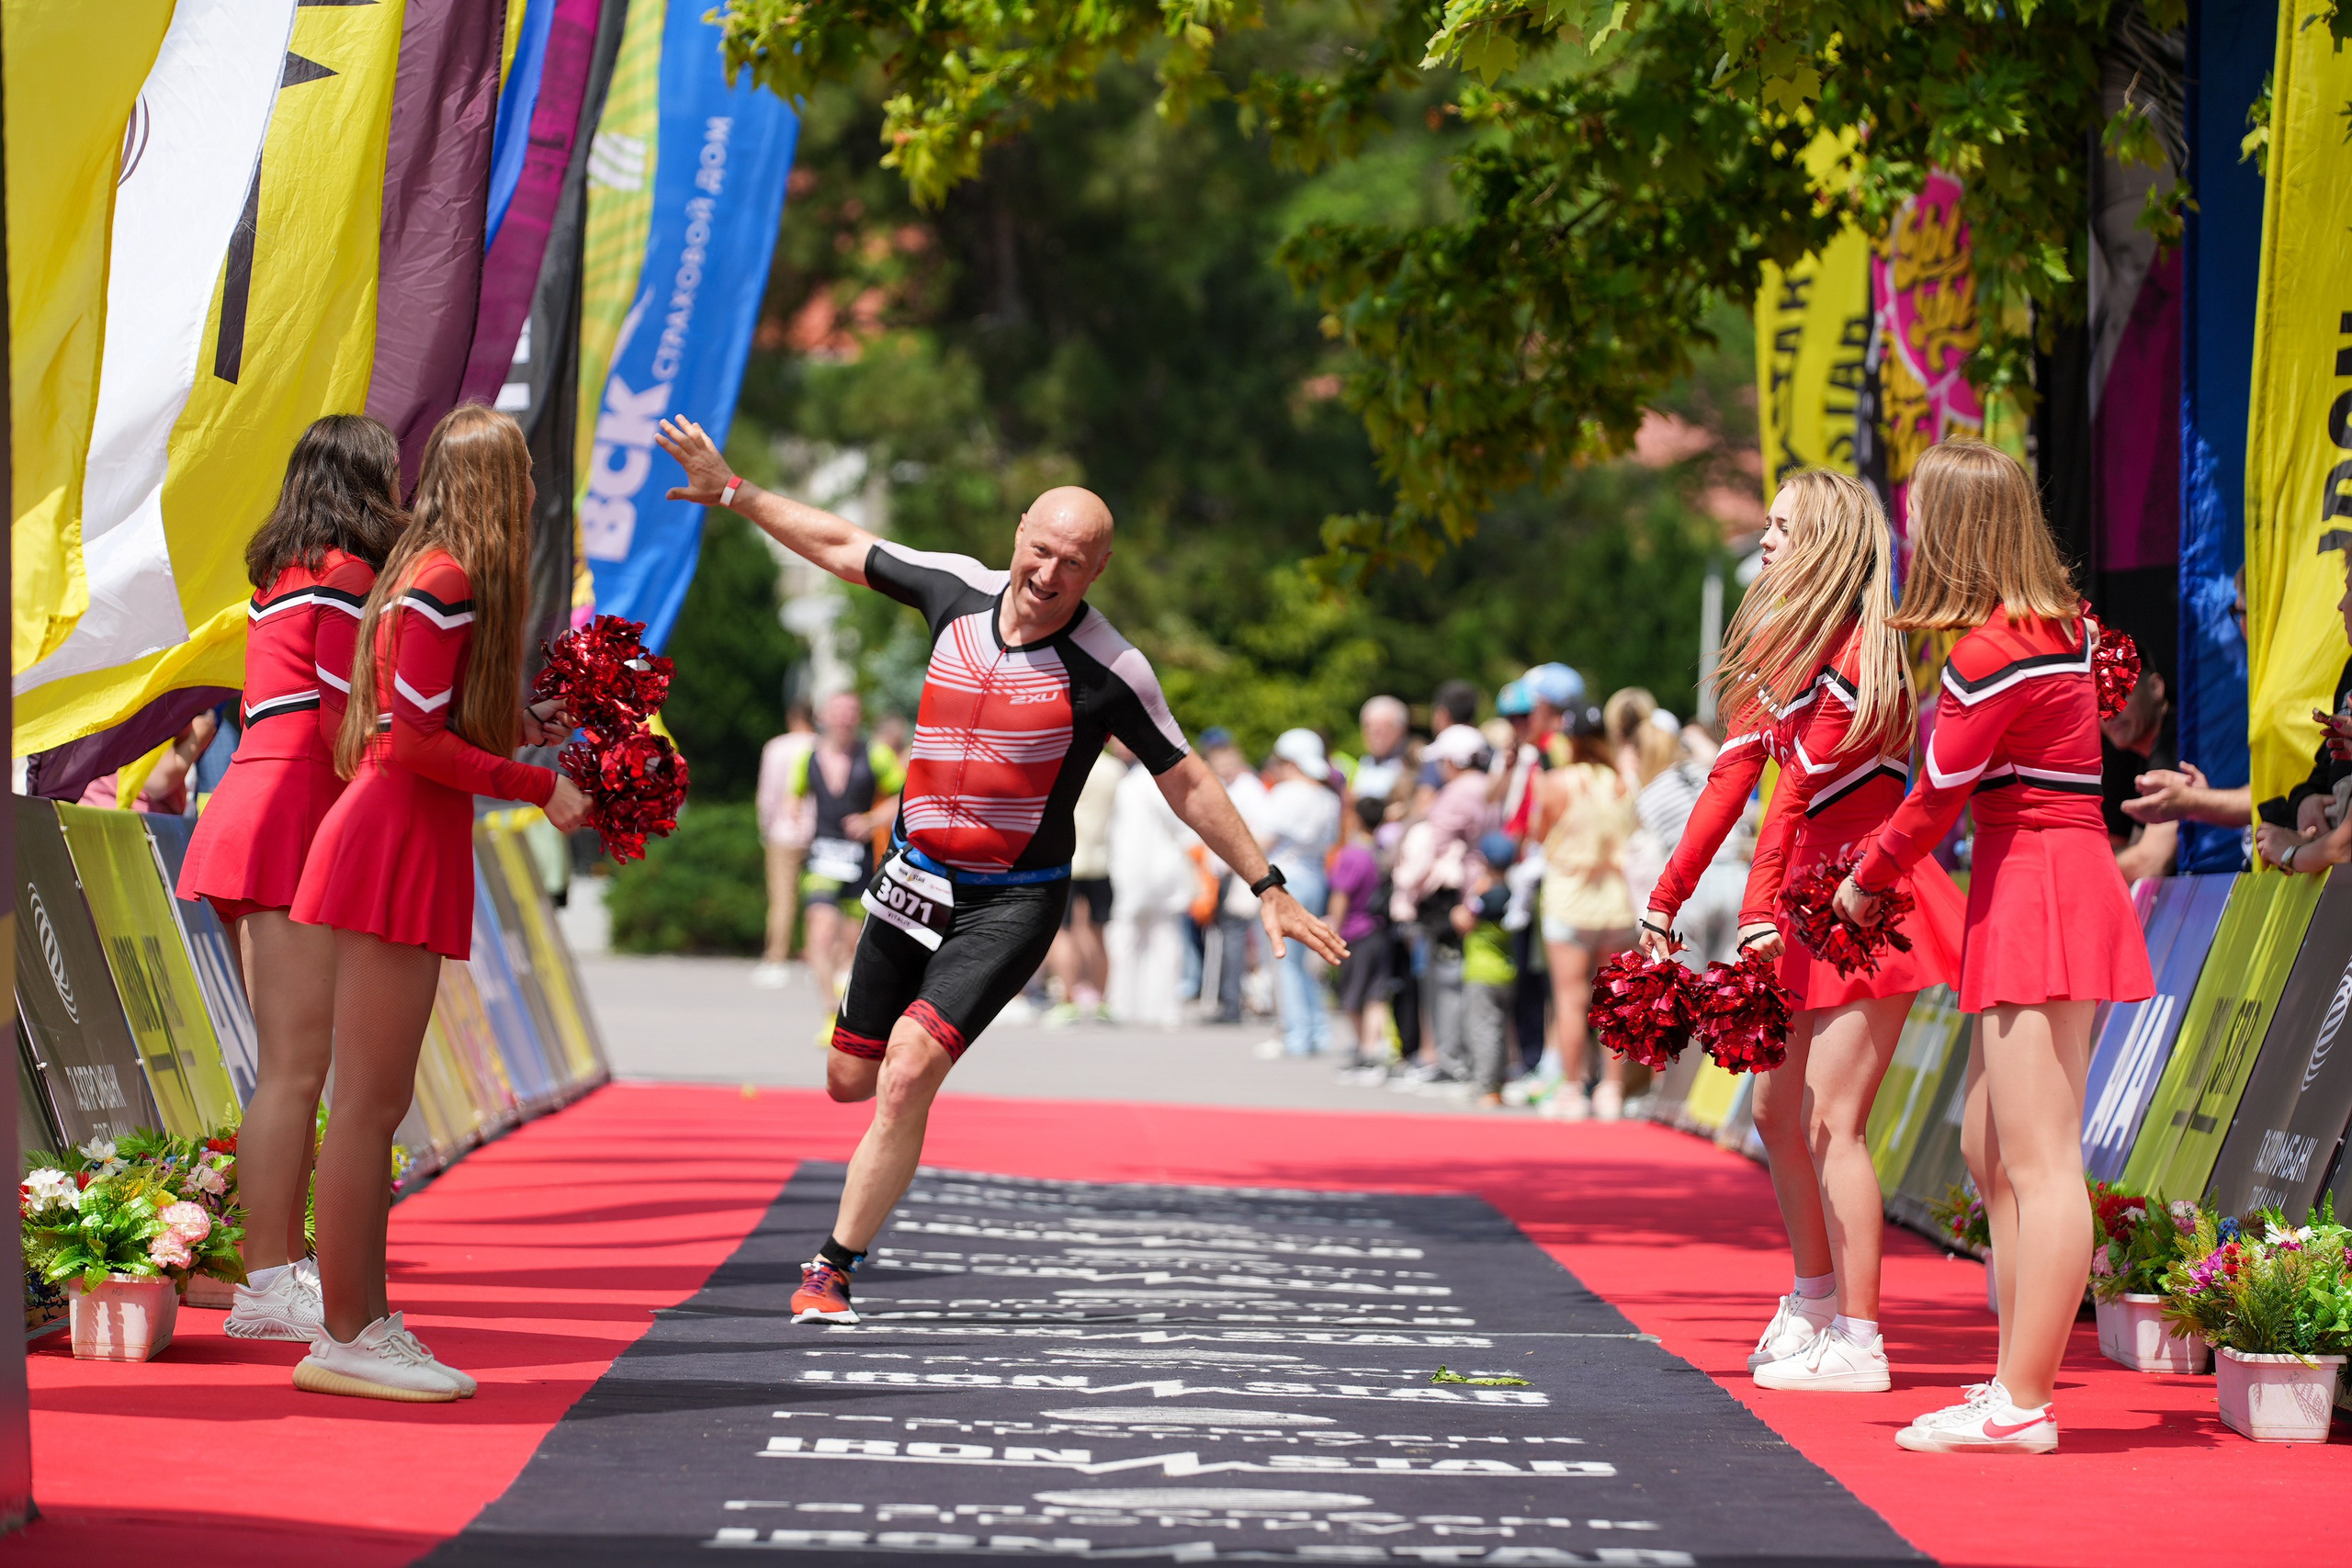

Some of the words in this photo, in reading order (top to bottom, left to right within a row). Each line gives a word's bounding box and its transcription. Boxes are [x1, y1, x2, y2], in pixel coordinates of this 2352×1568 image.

[651, 196, 717, 381] СТРАХОВОЙ
[695, 116, 734, 197] ДОМ
[581, 375, 673, 562] ВСК
[1009, 691, 1058, 705] 2XU
[876, 875, 933, 925] 3071
[65, 1064, 127, 1111] ГАЗПРОМБАНК
[2253, 1129, 2319, 1183] ГАЗПРОМБАНК
[803, 1370, 1089, 1387] IRON
[1244, 1381, 1551, 1406] STAR
[766, 1436, 1092, 1464] IRON
[1268, 1454, 1618, 1475] STAR
[715, 1526, 1091, 1551] IRON
[1295, 1544, 1697, 1567] STAR
